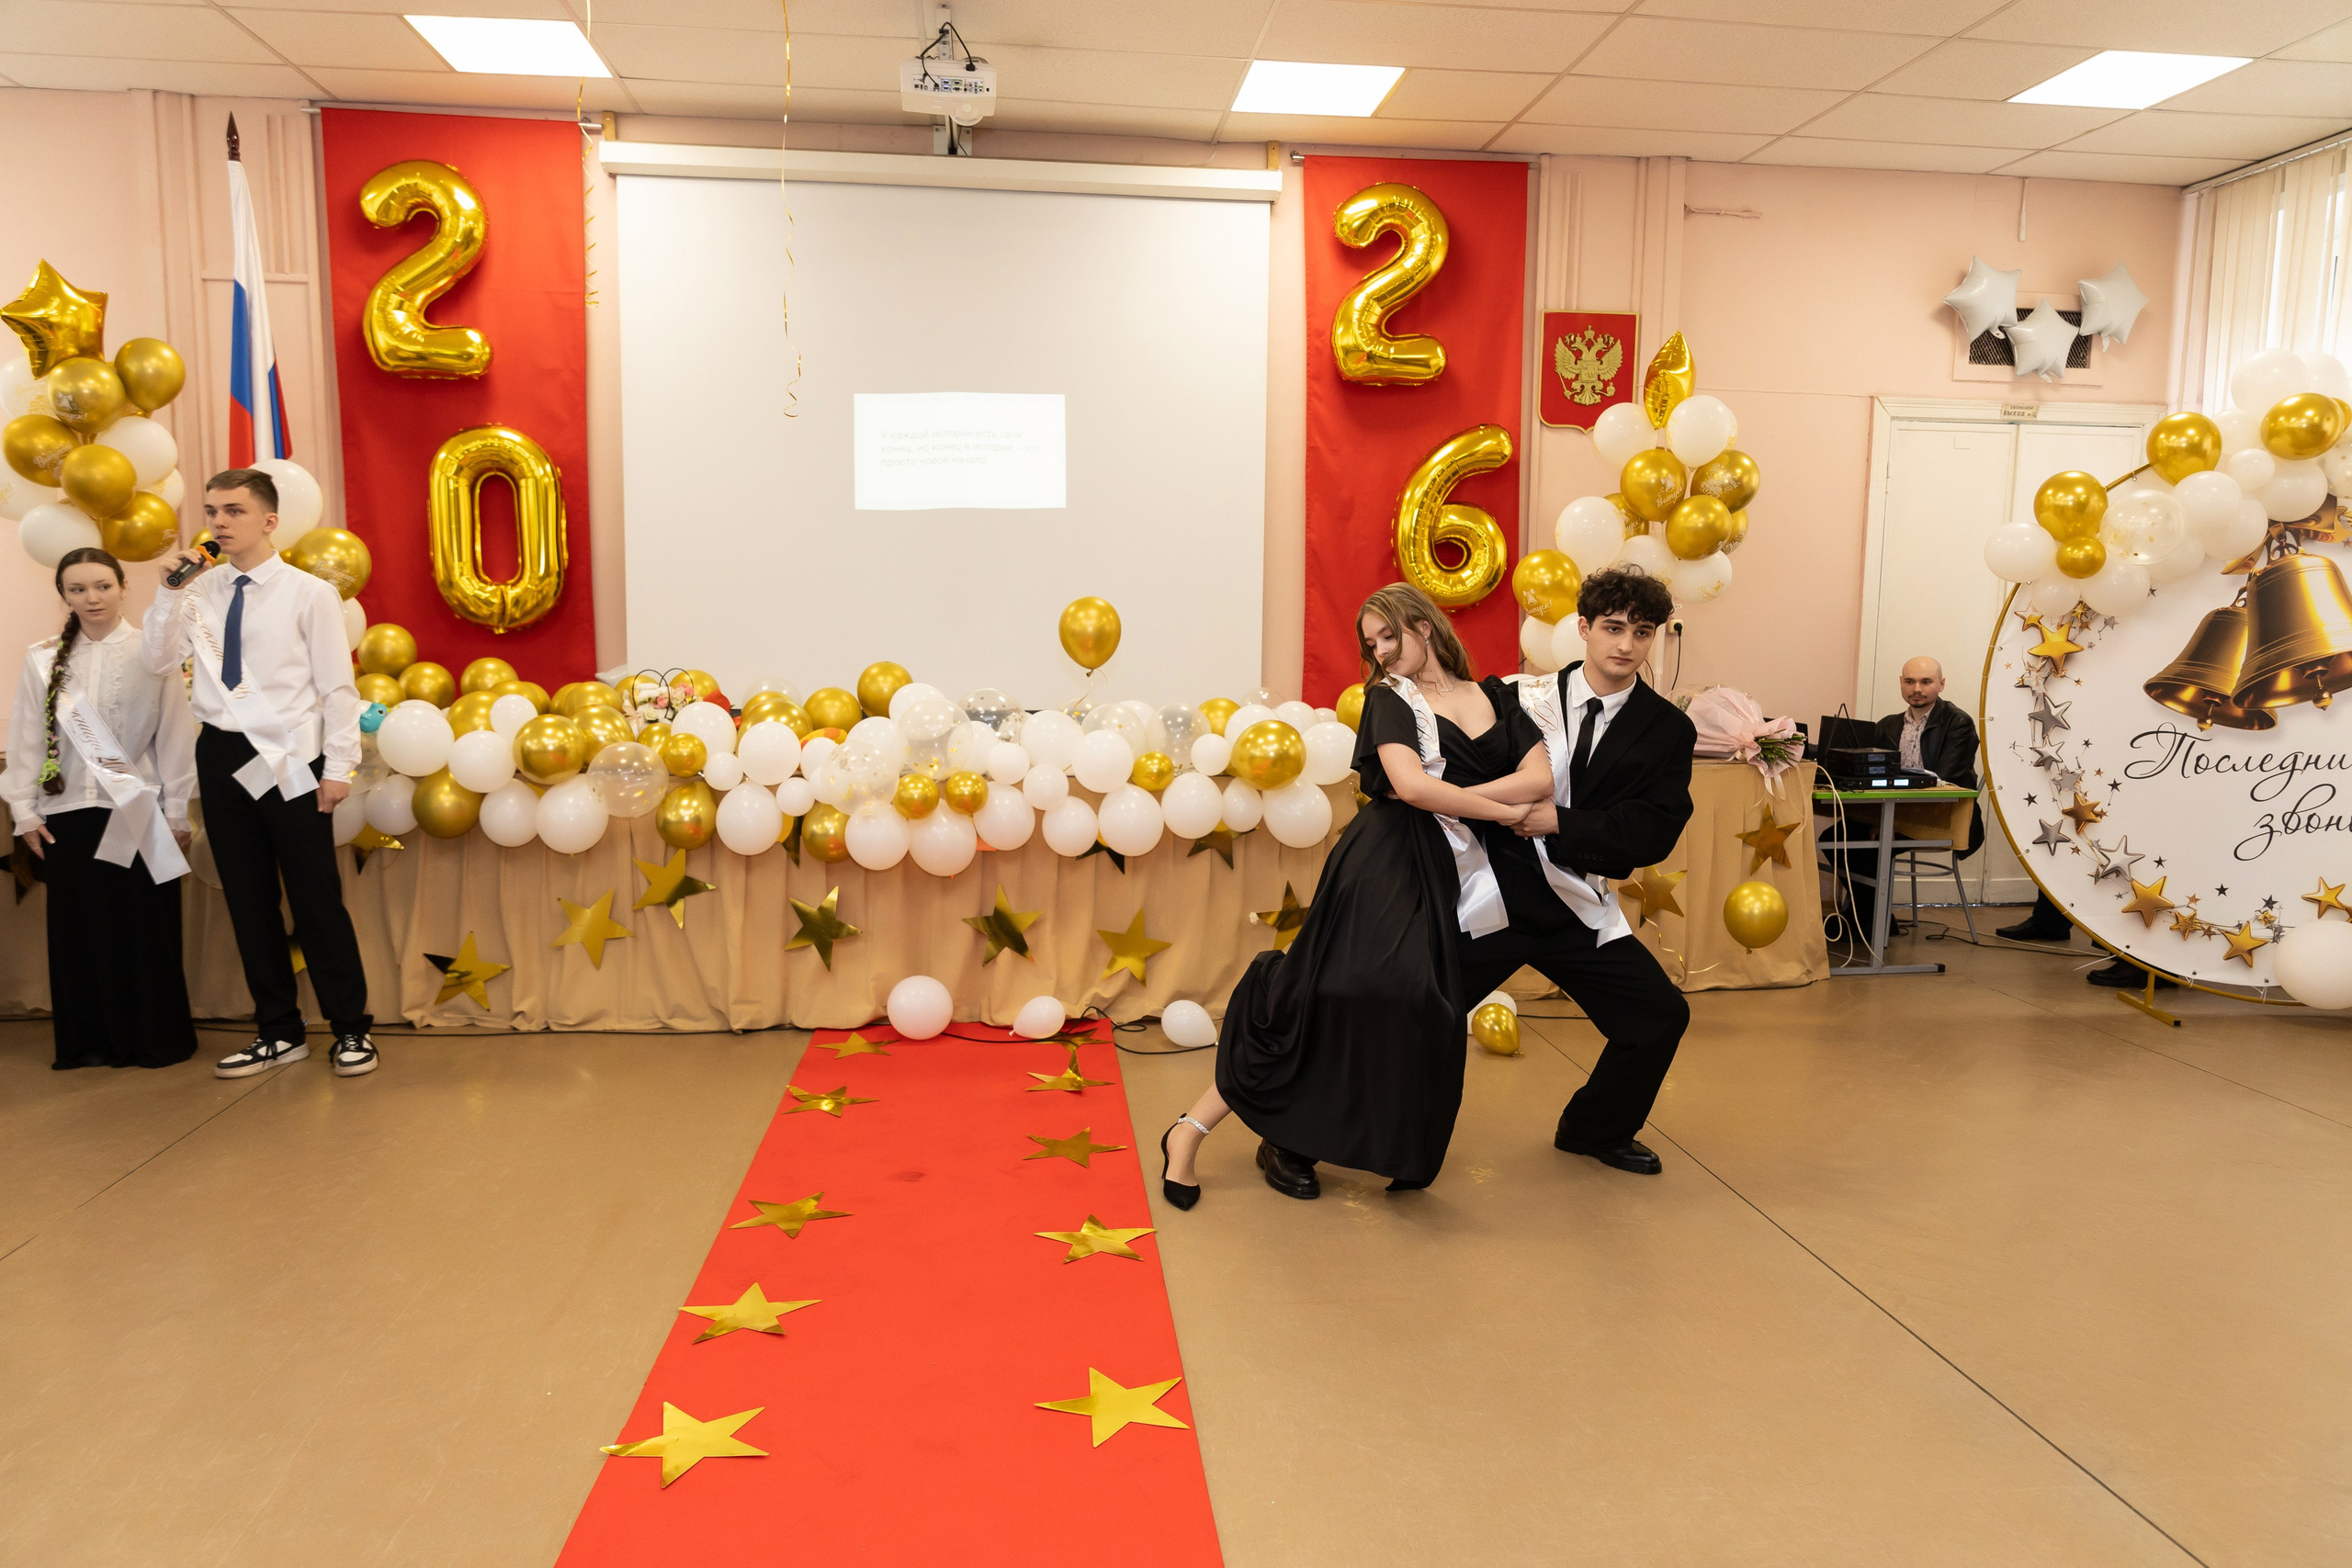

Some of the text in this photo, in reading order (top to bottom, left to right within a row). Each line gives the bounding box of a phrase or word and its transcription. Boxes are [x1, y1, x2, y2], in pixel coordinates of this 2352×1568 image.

[360, 159, 493, 379] 2
[1330, 181, 1449, 387] 2
[1391, 423, 1513, 612] 6
[2233, 784, 2352, 861] звон
